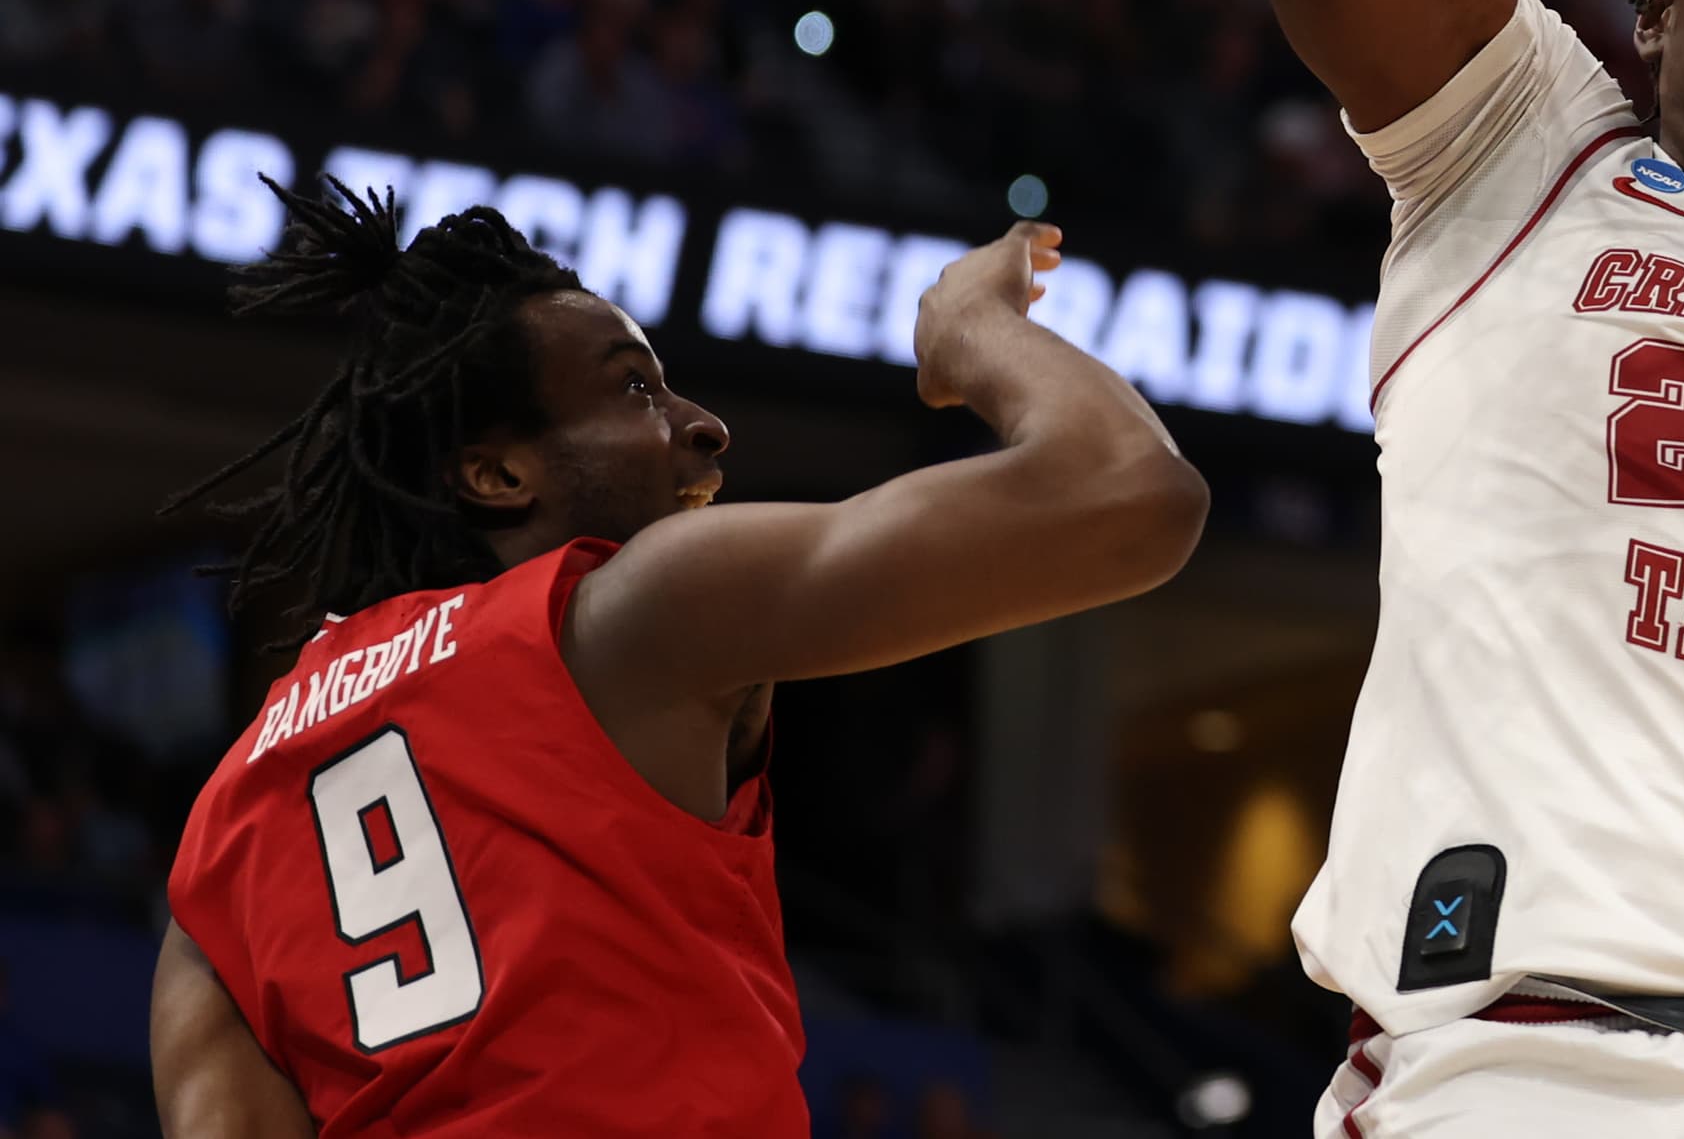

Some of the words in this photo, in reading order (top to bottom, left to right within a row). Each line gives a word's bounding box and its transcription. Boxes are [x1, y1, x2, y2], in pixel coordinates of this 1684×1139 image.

[0, 91, 293, 263] XAS
[1636, 165, 1682, 189] NCAA
[247, 593, 465, 764] BAMGBOYE
[307, 722, 485, 1055] 9
